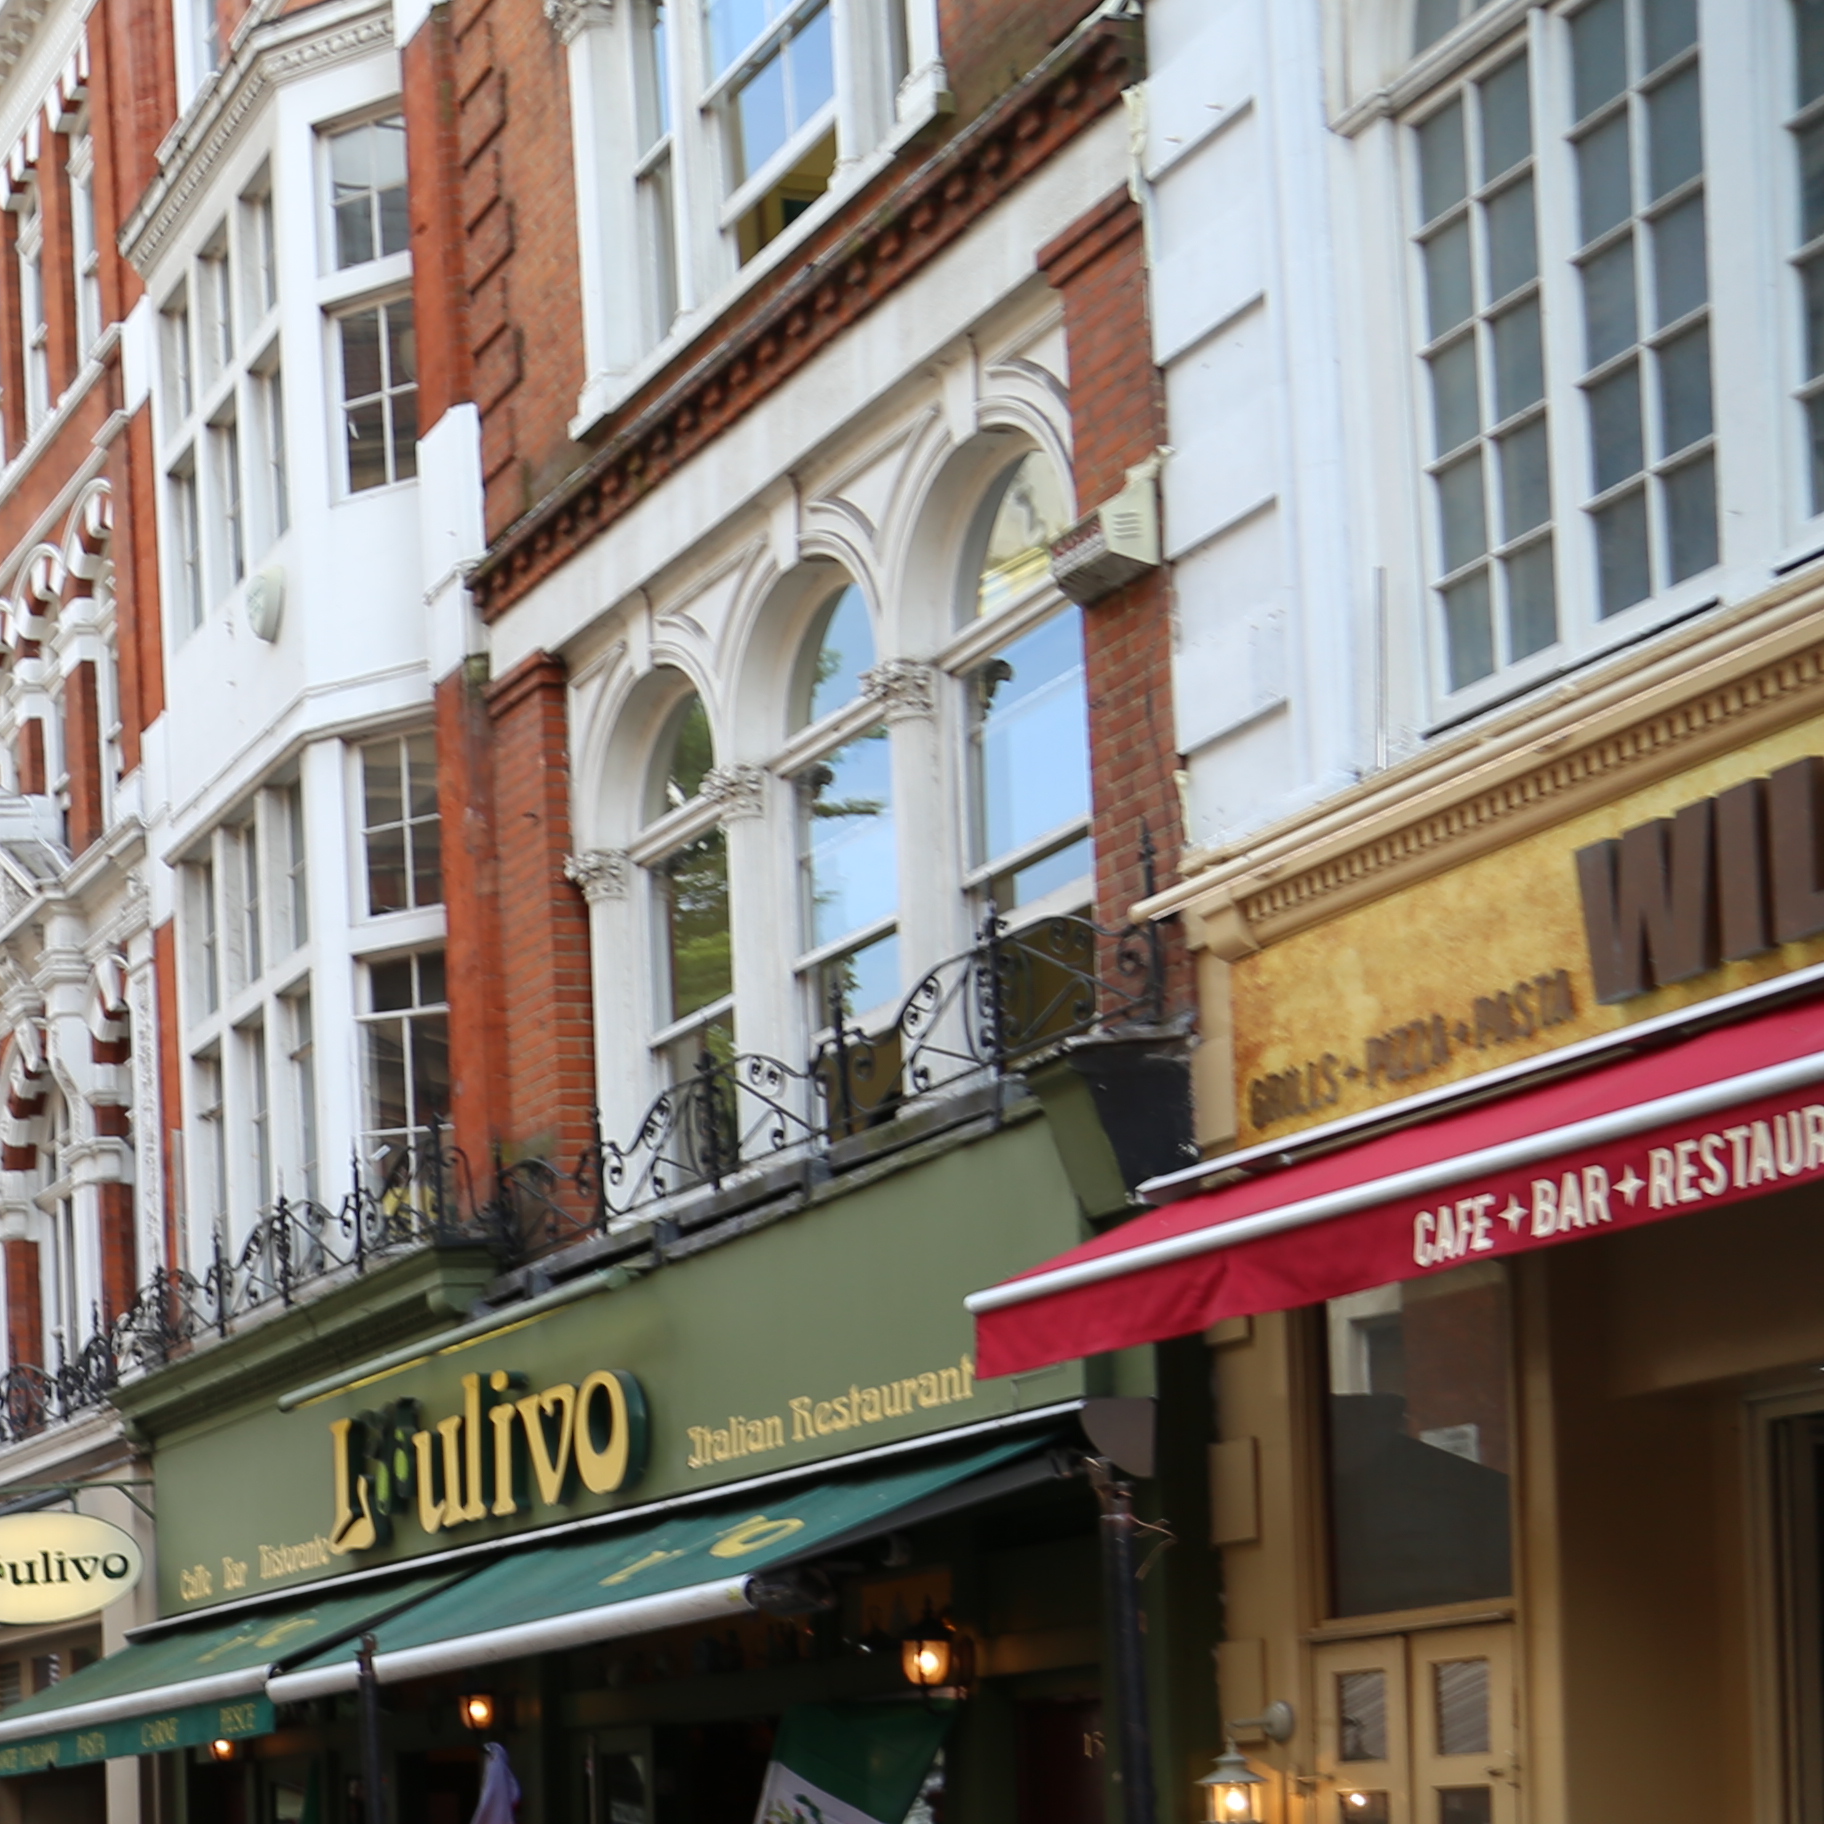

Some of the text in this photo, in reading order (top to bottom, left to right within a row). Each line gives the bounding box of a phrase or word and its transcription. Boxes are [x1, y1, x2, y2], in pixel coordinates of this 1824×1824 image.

[1474, 968, 1576, 1050] PASTA
[1413, 1193, 1496, 1268] CAFE
[1530, 1164, 1612, 1238] BAR
[686, 1353, 975, 1469] Italian Restaurant
